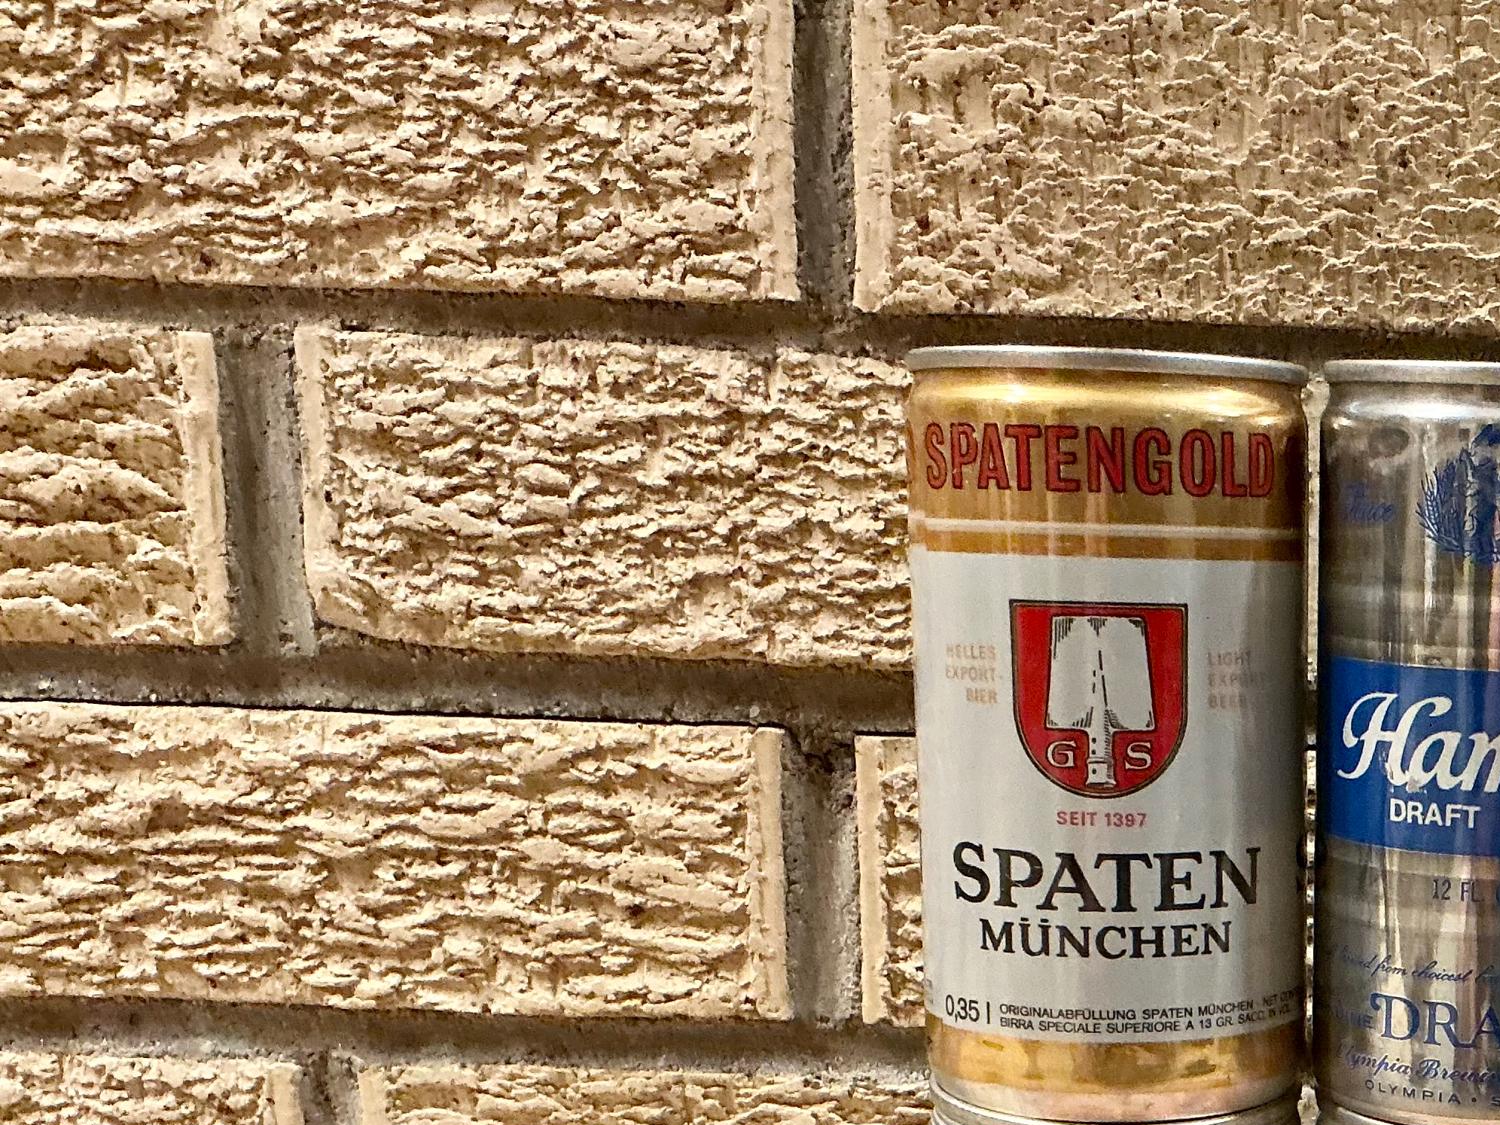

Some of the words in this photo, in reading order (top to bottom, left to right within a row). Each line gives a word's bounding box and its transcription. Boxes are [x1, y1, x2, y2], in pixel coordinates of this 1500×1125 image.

[925, 422, 1274, 498] SPATENGOLD
[966, 687, 998, 704] BIER
[1046, 741, 1076, 768] G
[1125, 742, 1153, 770] S
[1057, 811, 1097, 827] SEIT
[1105, 812, 1148, 828] 1397
[1389, 798, 1481, 831] DRAFT
[953, 841, 1261, 912] SPATEN
[1432, 879, 1451, 901] 12
[979, 916, 1232, 959] MÜNCHEN
[1371, 954, 1407, 978] from
[1412, 961, 1473, 983] choicest
[945, 994, 981, 1023] 0,35
[1000, 1003, 1137, 1021] ORIGINALABFÜLLUNG
[1142, 1007, 1193, 1021] SPATEN
[1198, 999, 1254, 1017] MÜNCHEN
[1000, 1017, 1035, 1031] BIRRA
[1039, 1018, 1101, 1033] SPECIALE
[1106, 1020, 1182, 1034] SUPERIORE
[1186, 1021, 1195, 1031] A
[1199, 1018, 1212, 1030] 13
[1365, 1079, 1461, 1104] OLYMPIA
